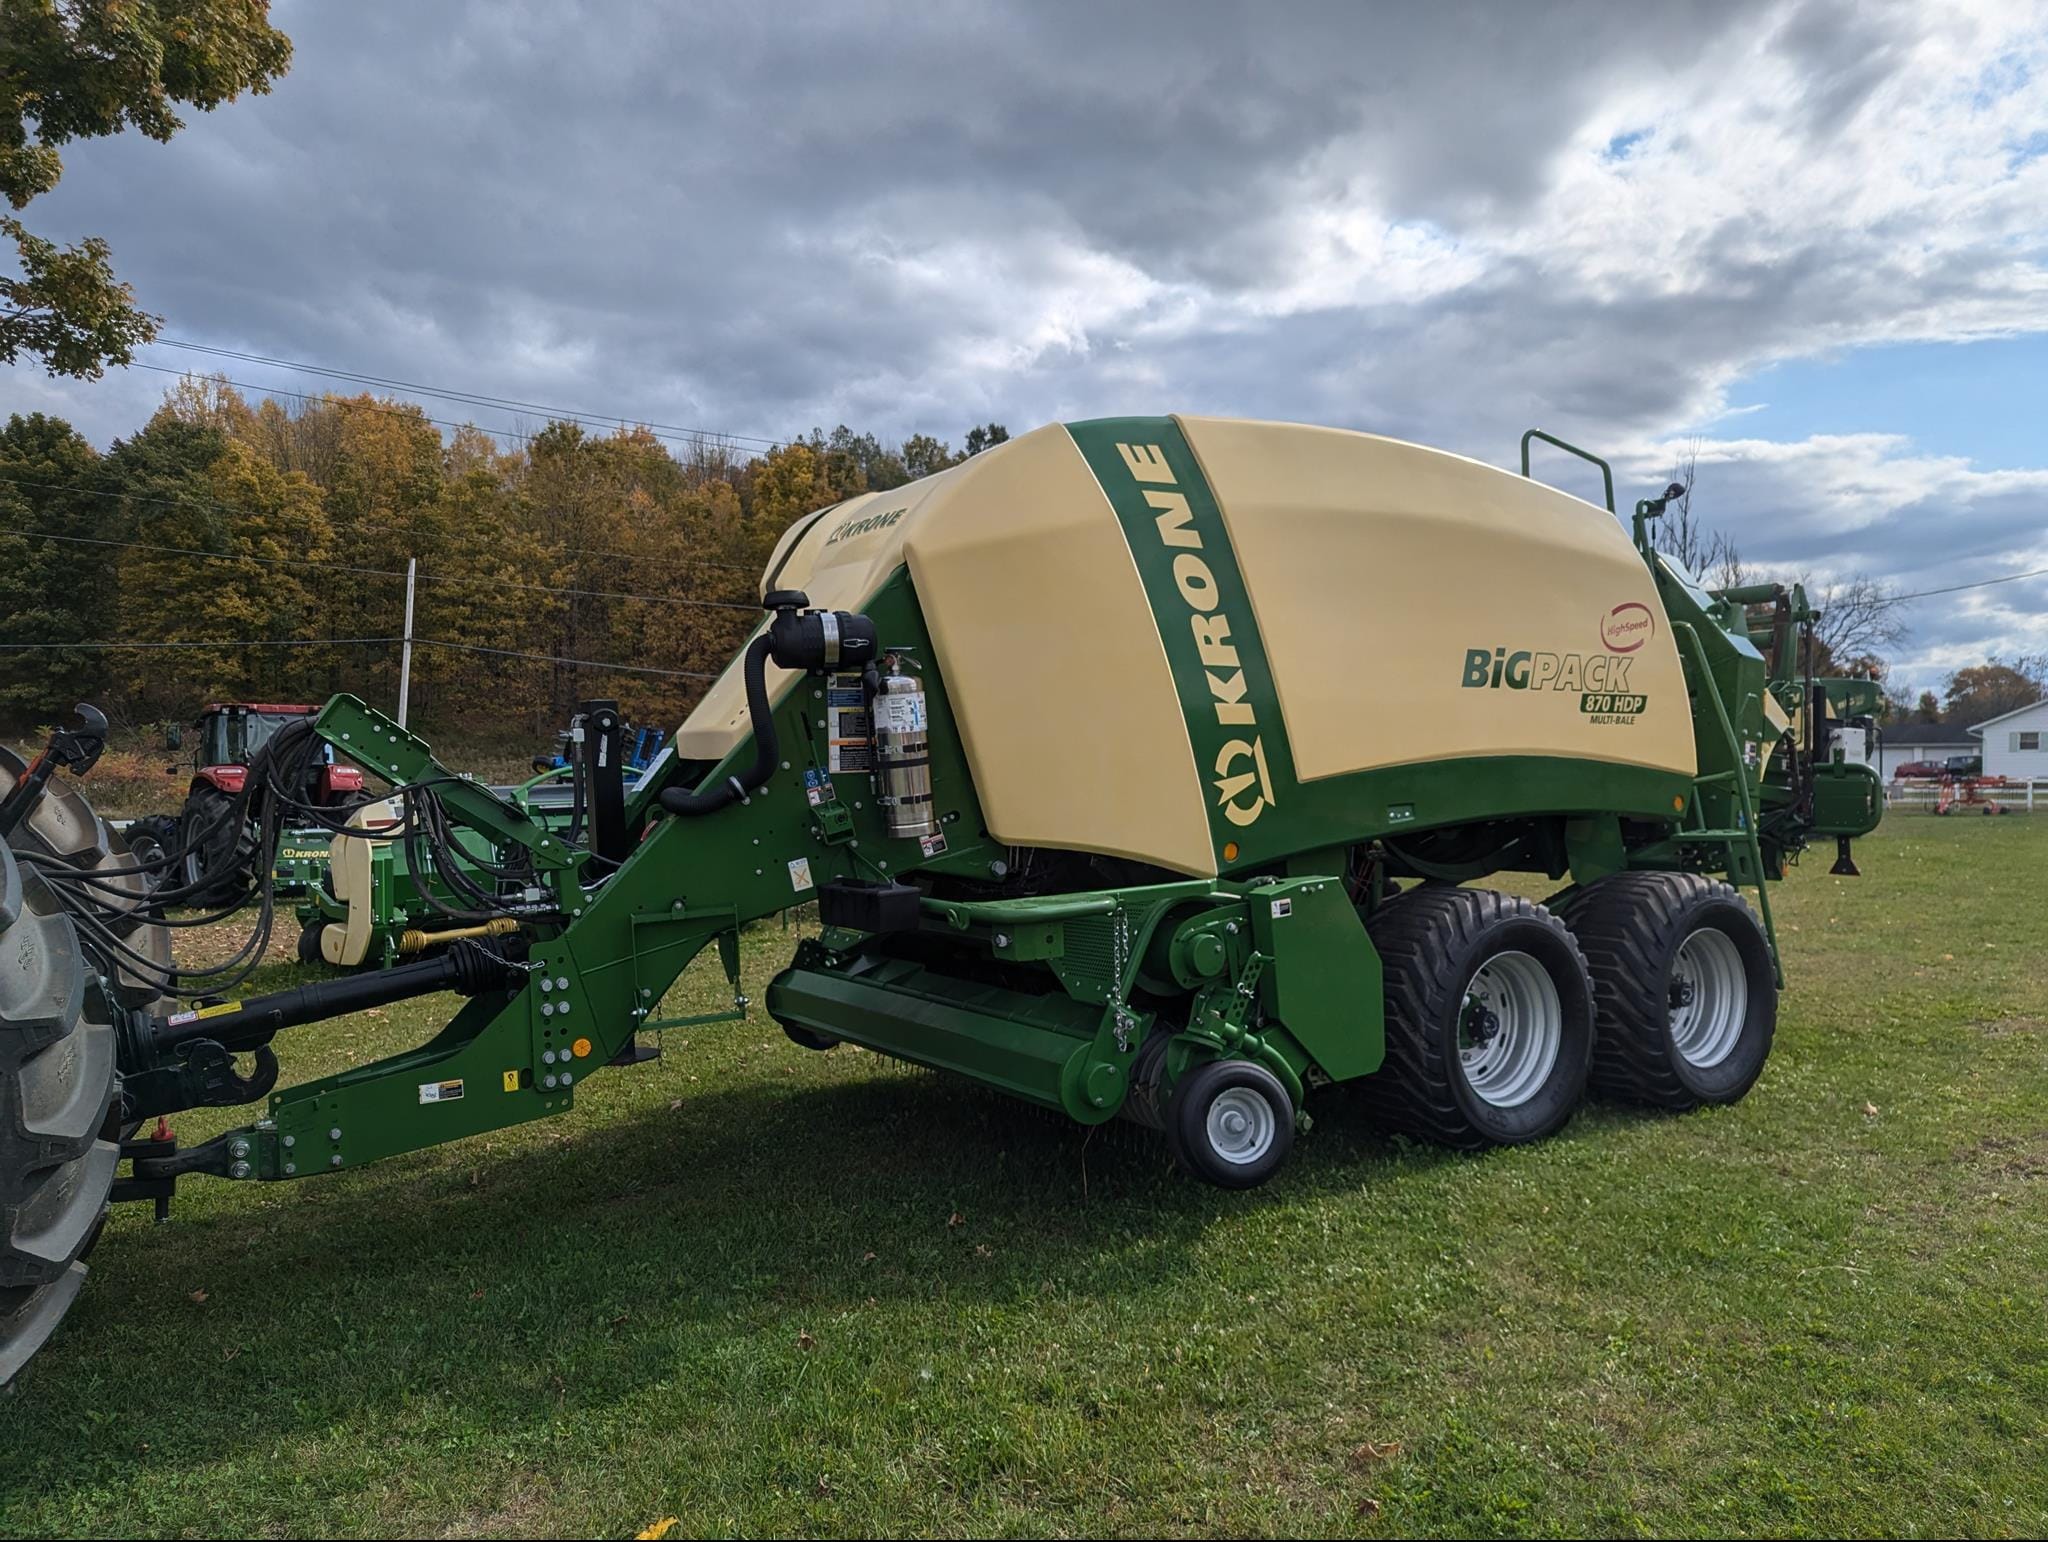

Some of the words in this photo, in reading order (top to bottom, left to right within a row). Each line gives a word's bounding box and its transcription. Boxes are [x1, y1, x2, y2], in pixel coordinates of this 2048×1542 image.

[841, 508, 907, 540] KRONE
[1115, 442, 1256, 725] KRONE
[1607, 618, 1649, 637] HighSpeed
[1585, 695, 1611, 712] 870
[1613, 696, 1643, 713] HDP
[1589, 715, 1636, 725] MULTI-BALE
[295, 850, 331, 858] KRON
